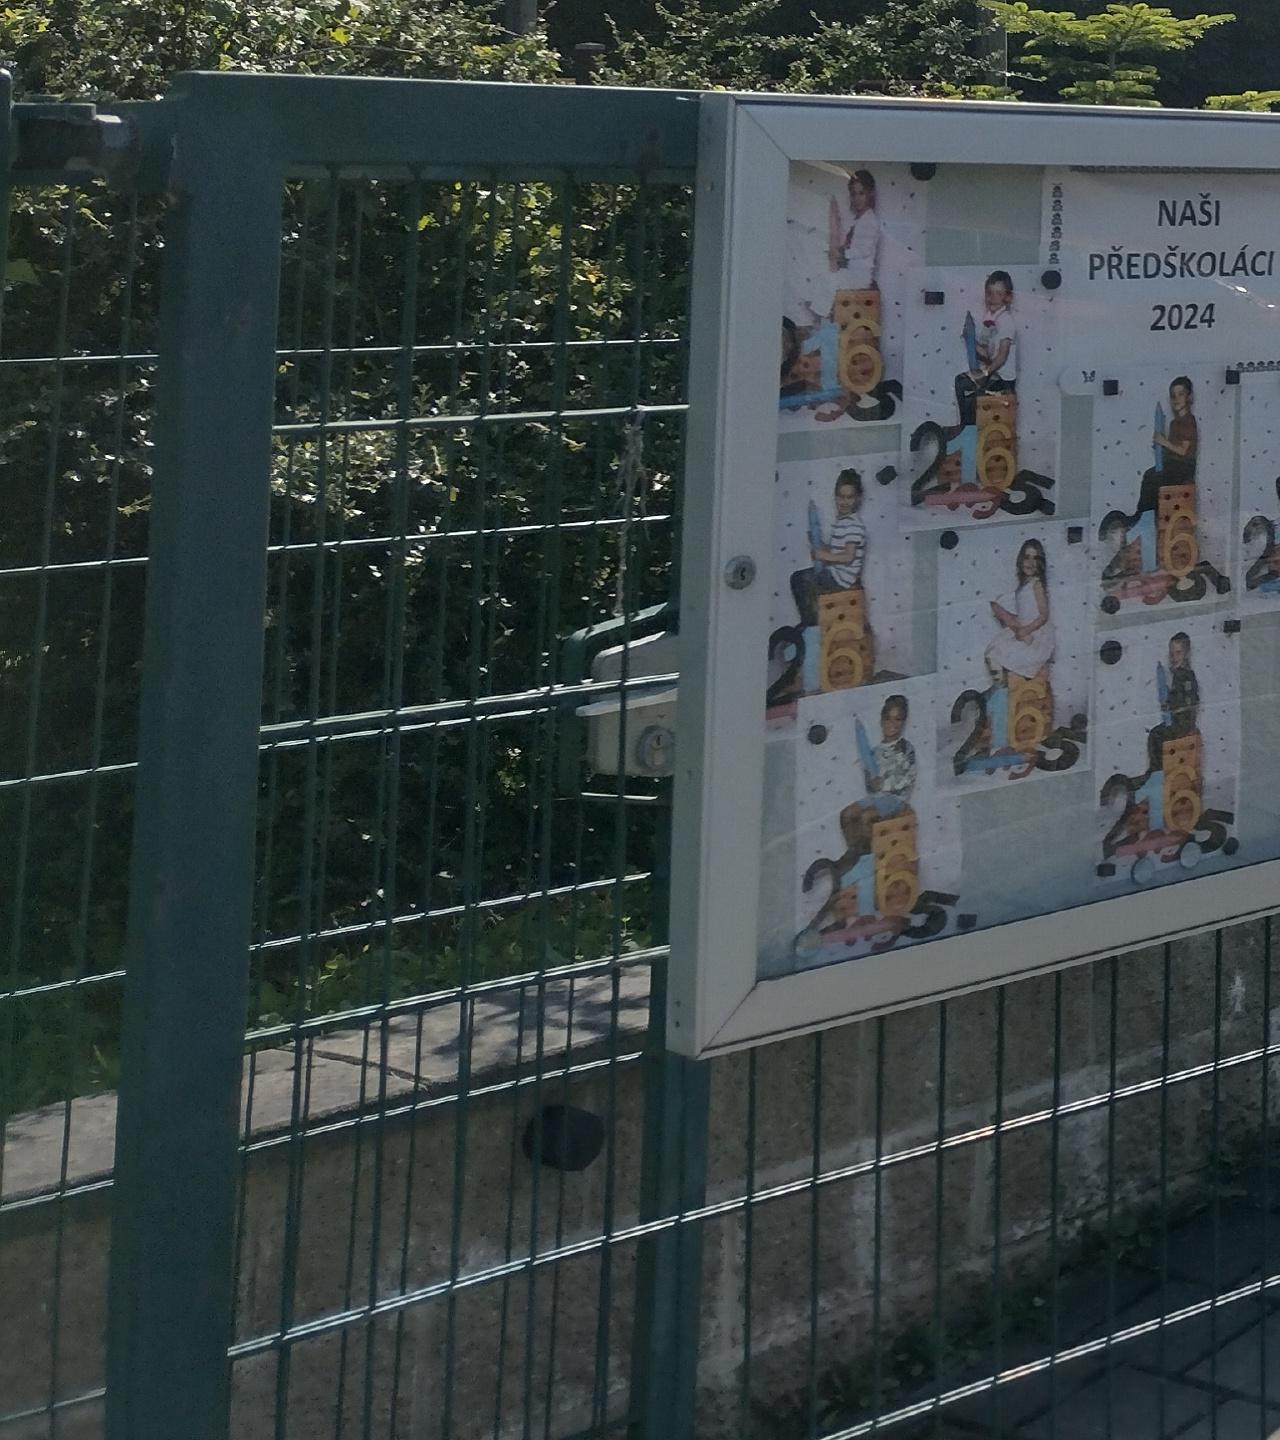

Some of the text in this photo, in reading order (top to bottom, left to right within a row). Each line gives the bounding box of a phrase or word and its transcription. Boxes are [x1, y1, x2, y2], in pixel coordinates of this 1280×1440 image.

[1157, 192, 1221, 227] NAŠI
[1088, 244, 1275, 280] PŘEDŠKOLÁCI
[1150, 303, 1216, 331] 2024
